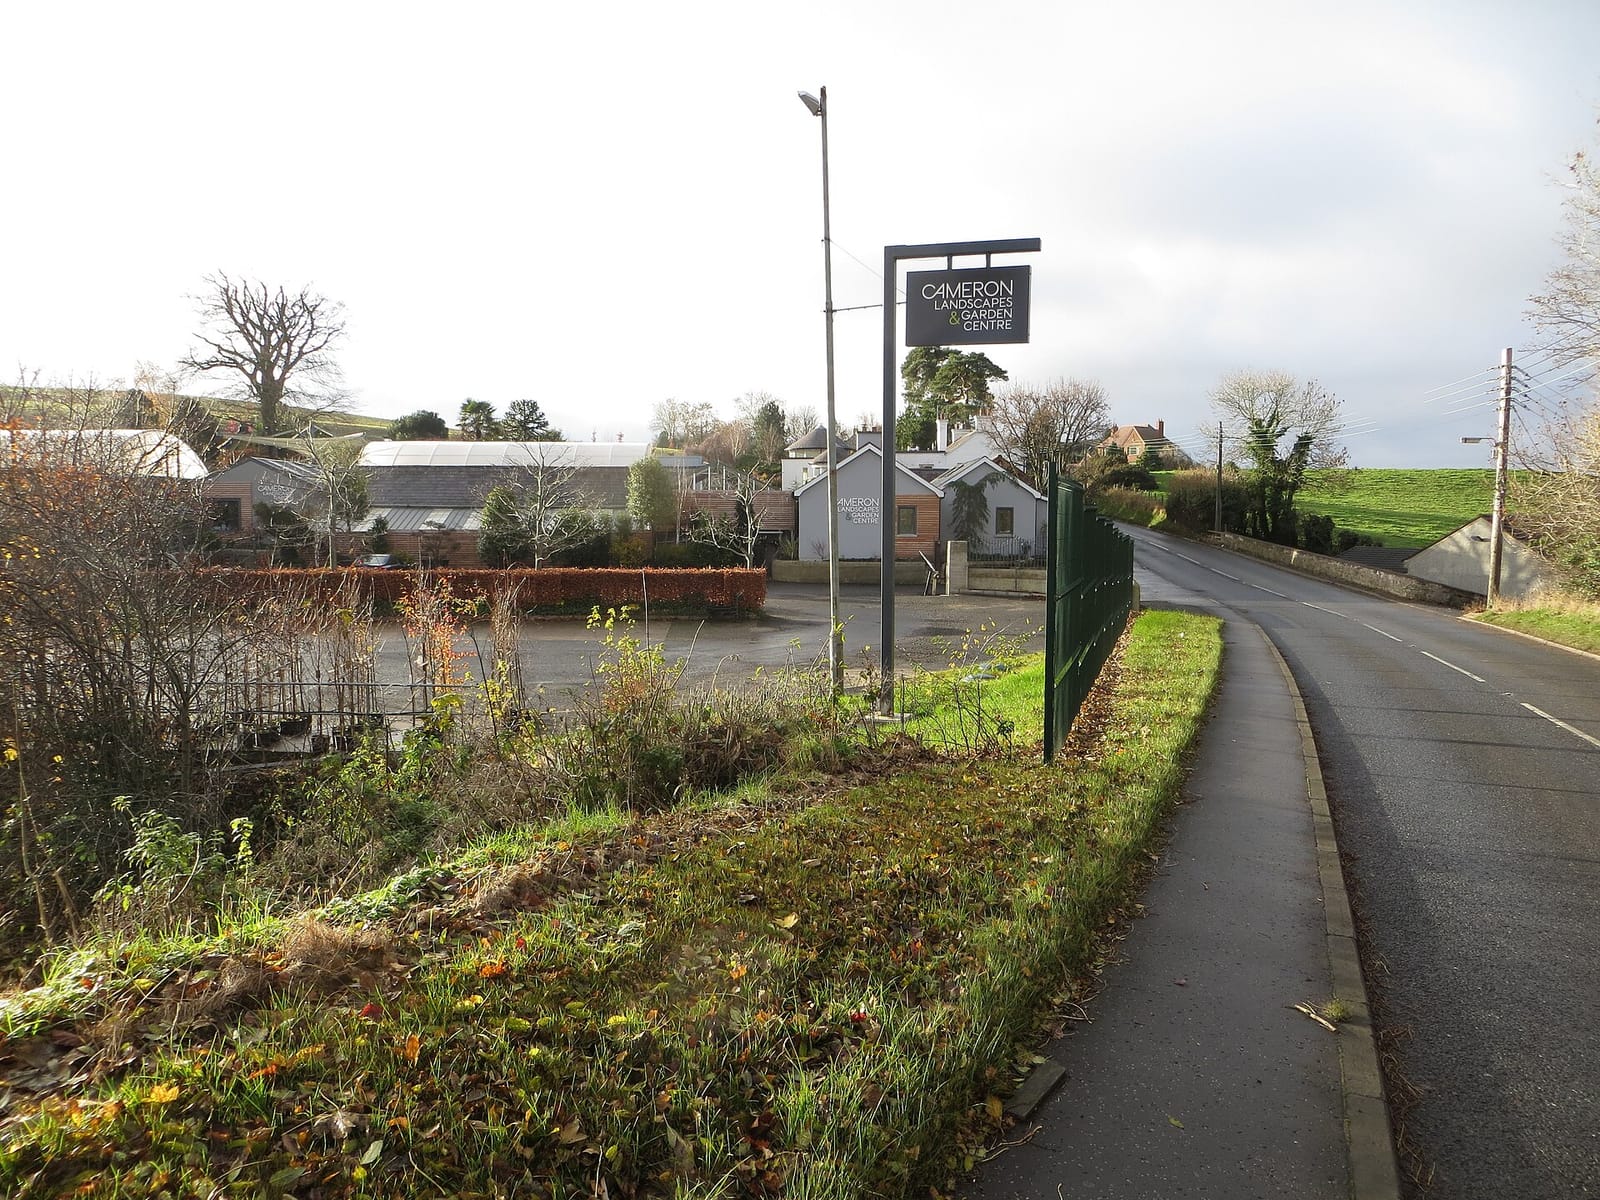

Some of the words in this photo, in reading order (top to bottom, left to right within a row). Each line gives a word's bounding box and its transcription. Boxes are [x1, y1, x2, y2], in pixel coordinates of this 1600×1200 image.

[921, 279, 1014, 300] CAMERON
[934, 297, 1013, 311] LANDSCAPES
[949, 311, 961, 326] &
[961, 308, 1013, 321] GARDEN
[963, 320, 1012, 331] CENTRE
[836, 497, 880, 507] AMERON
